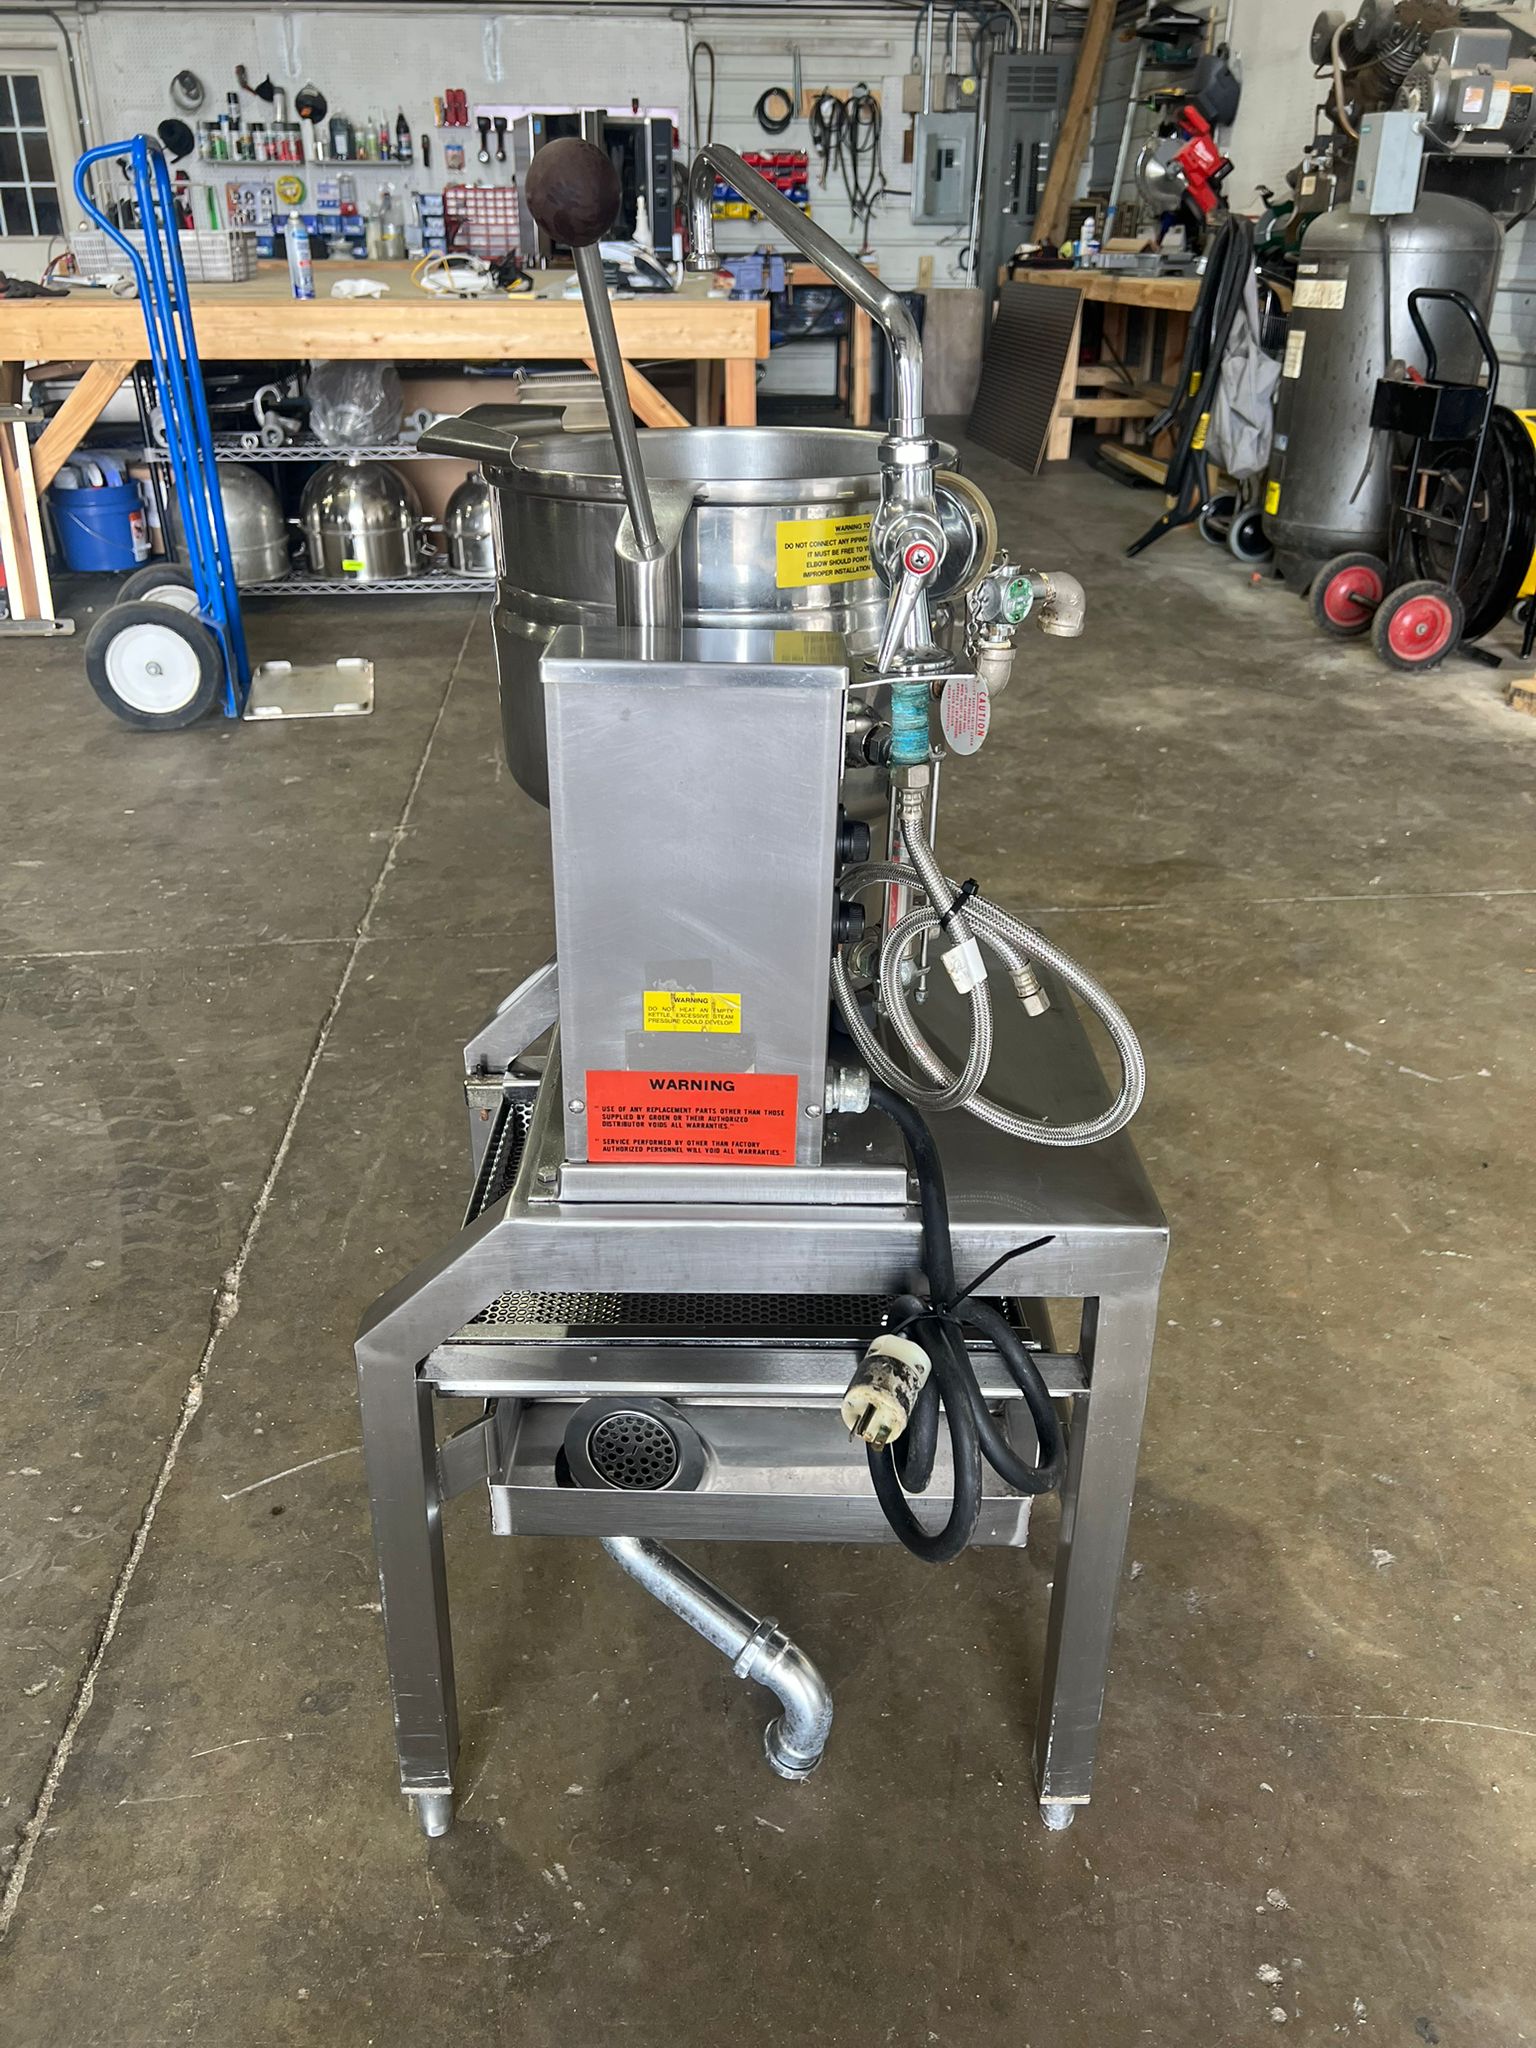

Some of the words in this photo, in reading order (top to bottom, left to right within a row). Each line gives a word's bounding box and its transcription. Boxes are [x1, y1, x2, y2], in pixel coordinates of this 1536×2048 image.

[835, 523, 862, 531] WARNING
[809, 539, 837, 547] CONNECT
[807, 560, 828, 568] ELBOW
[852, 555, 867, 563] POINT
[803, 570, 833, 578] IMPROPER
[834, 565, 870, 575] INSTALLATION
[977, 691, 987, 737] CAUTION
[649, 1078, 735, 1092] WARNING
